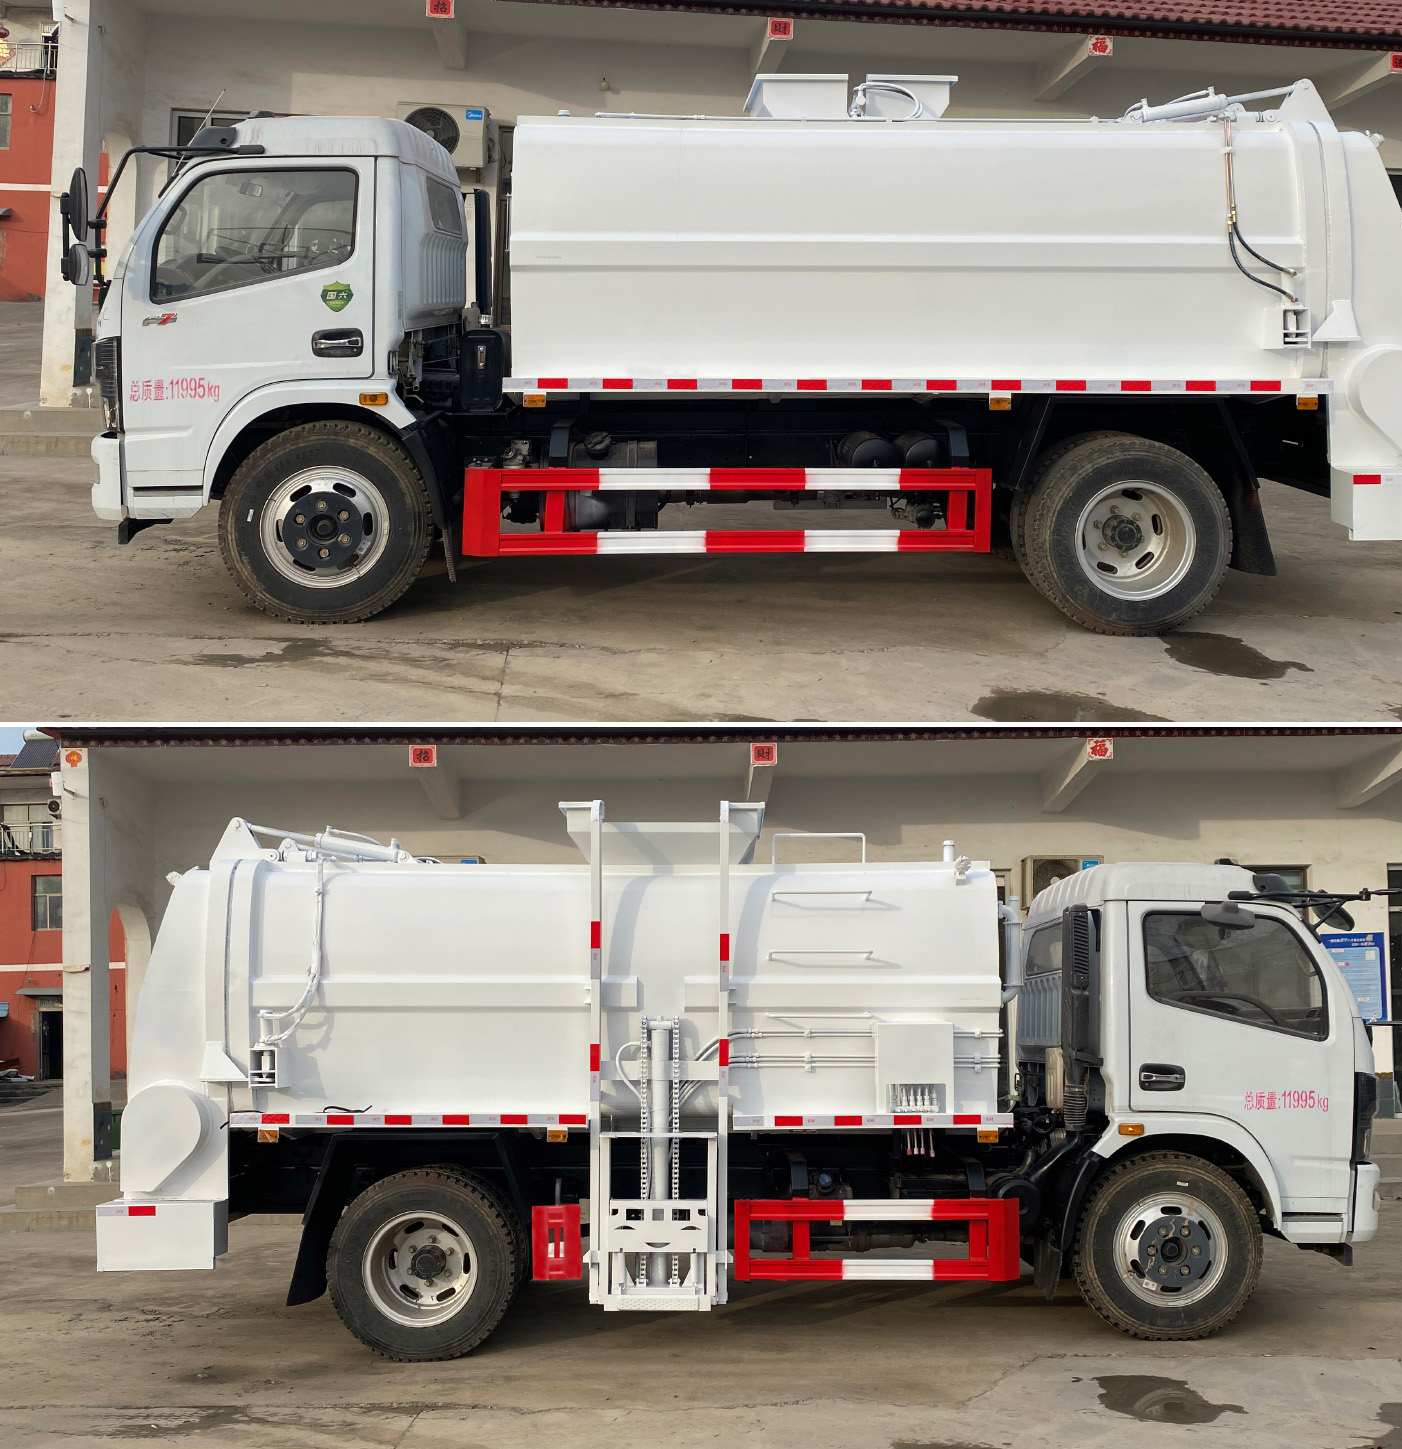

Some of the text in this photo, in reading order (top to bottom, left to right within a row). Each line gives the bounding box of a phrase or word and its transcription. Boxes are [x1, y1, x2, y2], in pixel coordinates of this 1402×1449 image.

[433, 1, 447, 13] 招
[1091, 36, 1109, 54] 福
[326, 291, 348, 300] 国六
[1090, 739, 1109, 757] 福
[416, 750, 430, 762] 招
